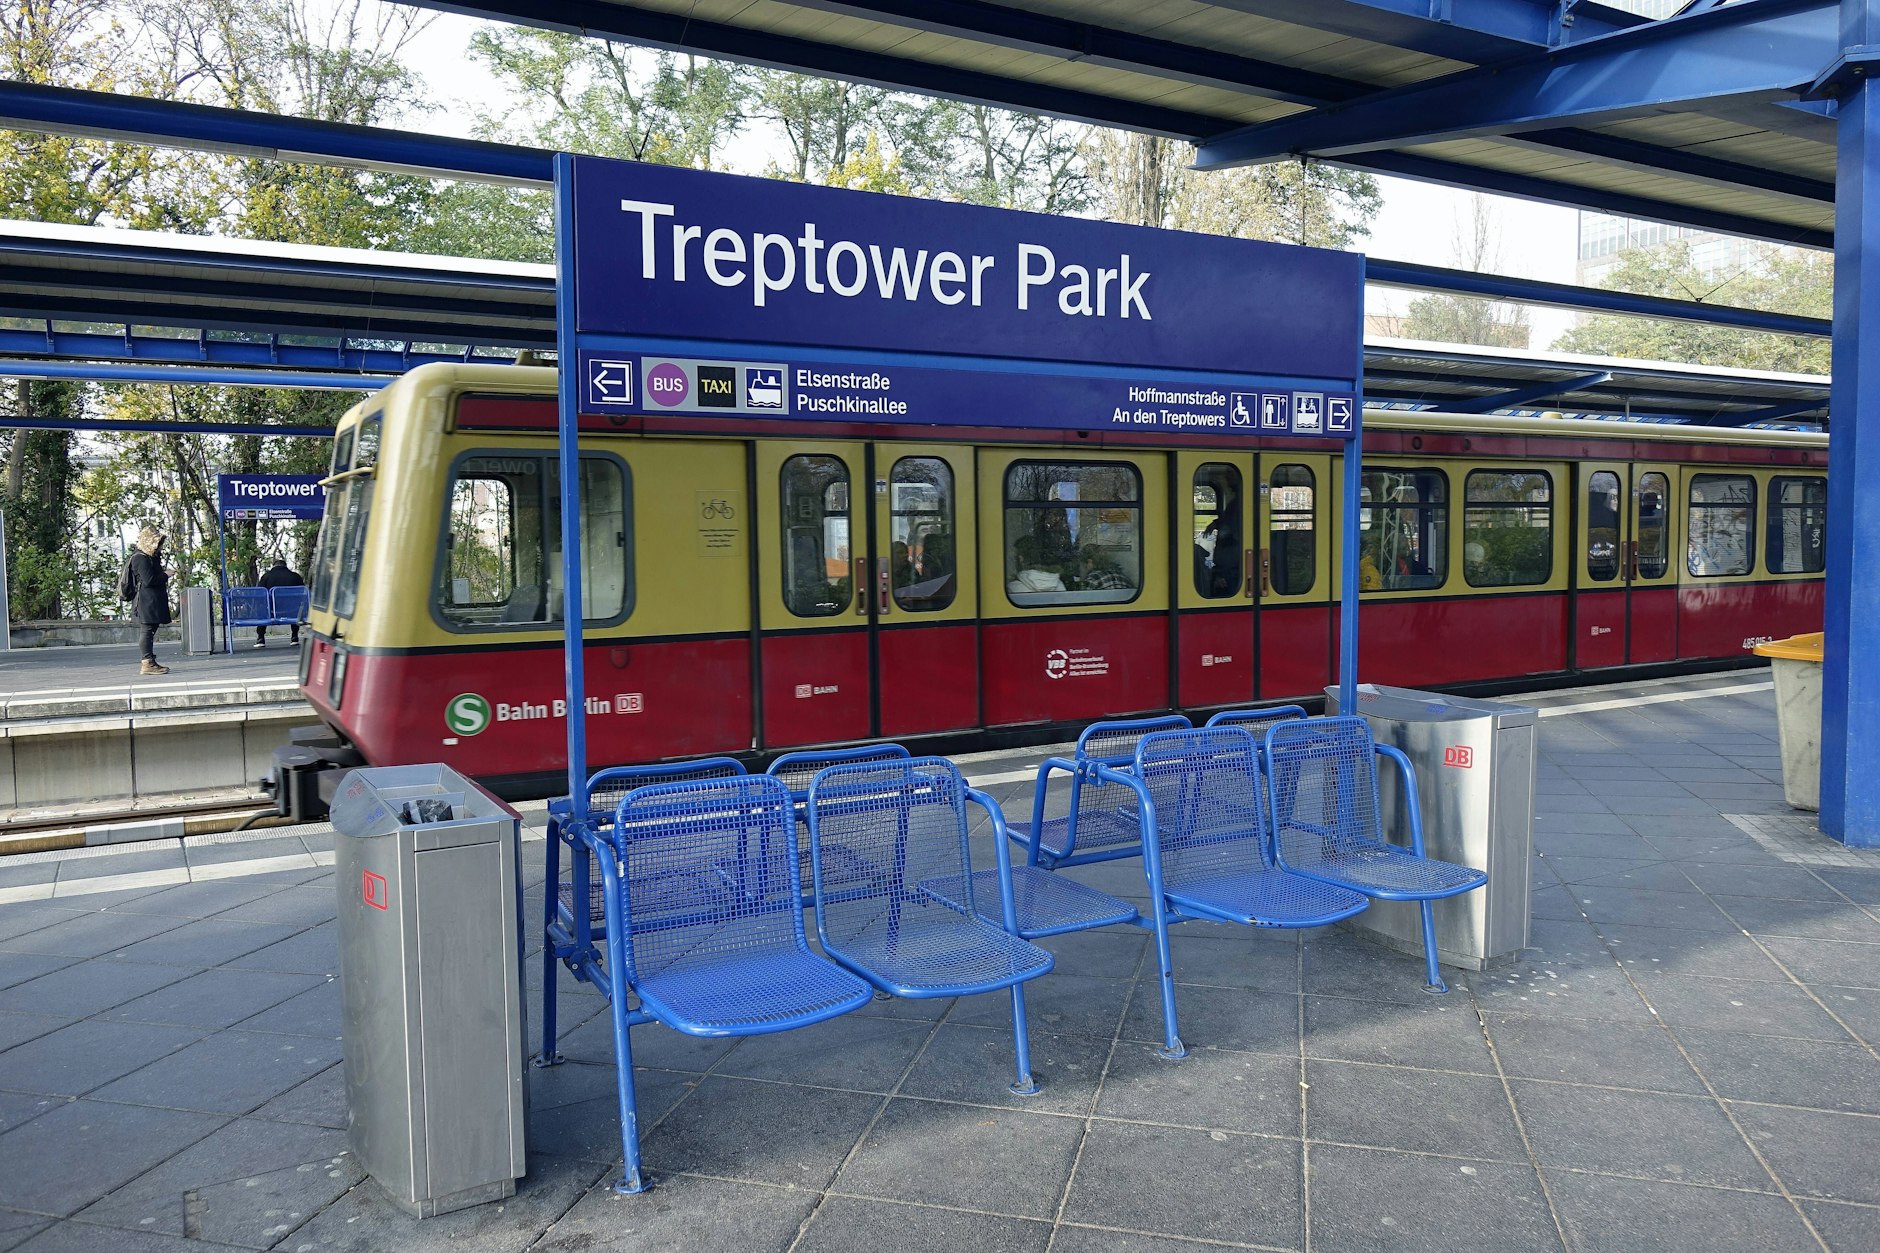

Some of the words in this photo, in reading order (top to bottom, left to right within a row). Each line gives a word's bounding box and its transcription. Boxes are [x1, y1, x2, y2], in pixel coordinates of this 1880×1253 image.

[621, 199, 994, 307] Treptower
[1017, 243, 1152, 320] Park
[653, 377, 683, 392] BUS
[701, 379, 732, 394] TAXI
[796, 369, 890, 390] Elsenstraße
[796, 394, 907, 415] Puschkinallee
[1129, 386, 1226, 406] Hoffmannstraße
[1112, 408, 1130, 423] An
[1133, 409, 1156, 424] den
[1160, 410, 1226, 428] Treptowers
[230, 480, 317, 499] Treptower
[1742, 637, 1755, 649] 485
[1048, 660, 1066, 669] VBB
[813, 685, 838, 695] BAHN
[453, 698, 485, 732] S
[496, 701, 548, 722] Bahn
[552, 696, 611, 718] Blin
[617, 695, 641, 712] DB
[1444, 746, 1470, 766] DB
